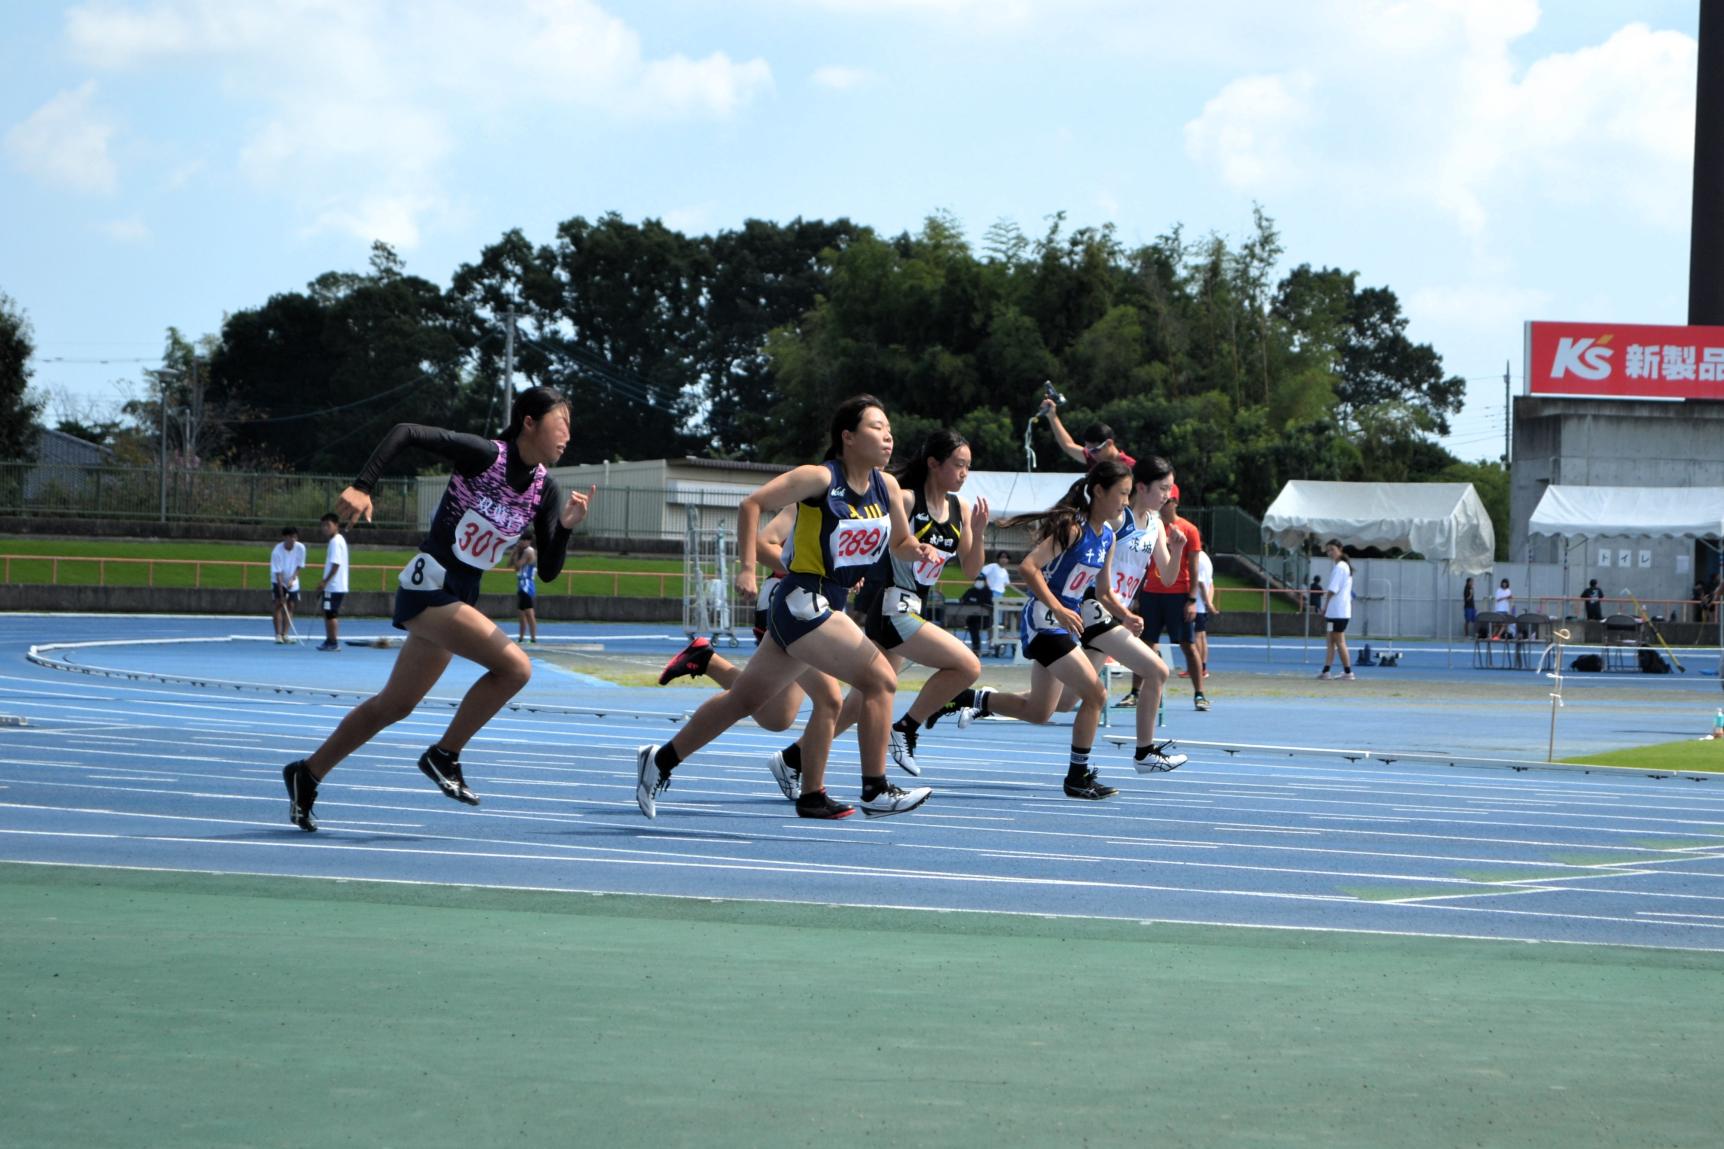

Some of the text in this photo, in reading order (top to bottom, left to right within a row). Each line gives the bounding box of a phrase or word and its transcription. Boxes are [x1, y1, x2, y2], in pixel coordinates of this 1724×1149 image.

[458, 522, 506, 563] 307
[411, 557, 425, 585] 8
[900, 592, 911, 614] 5
[1044, 609, 1055, 626] 4
